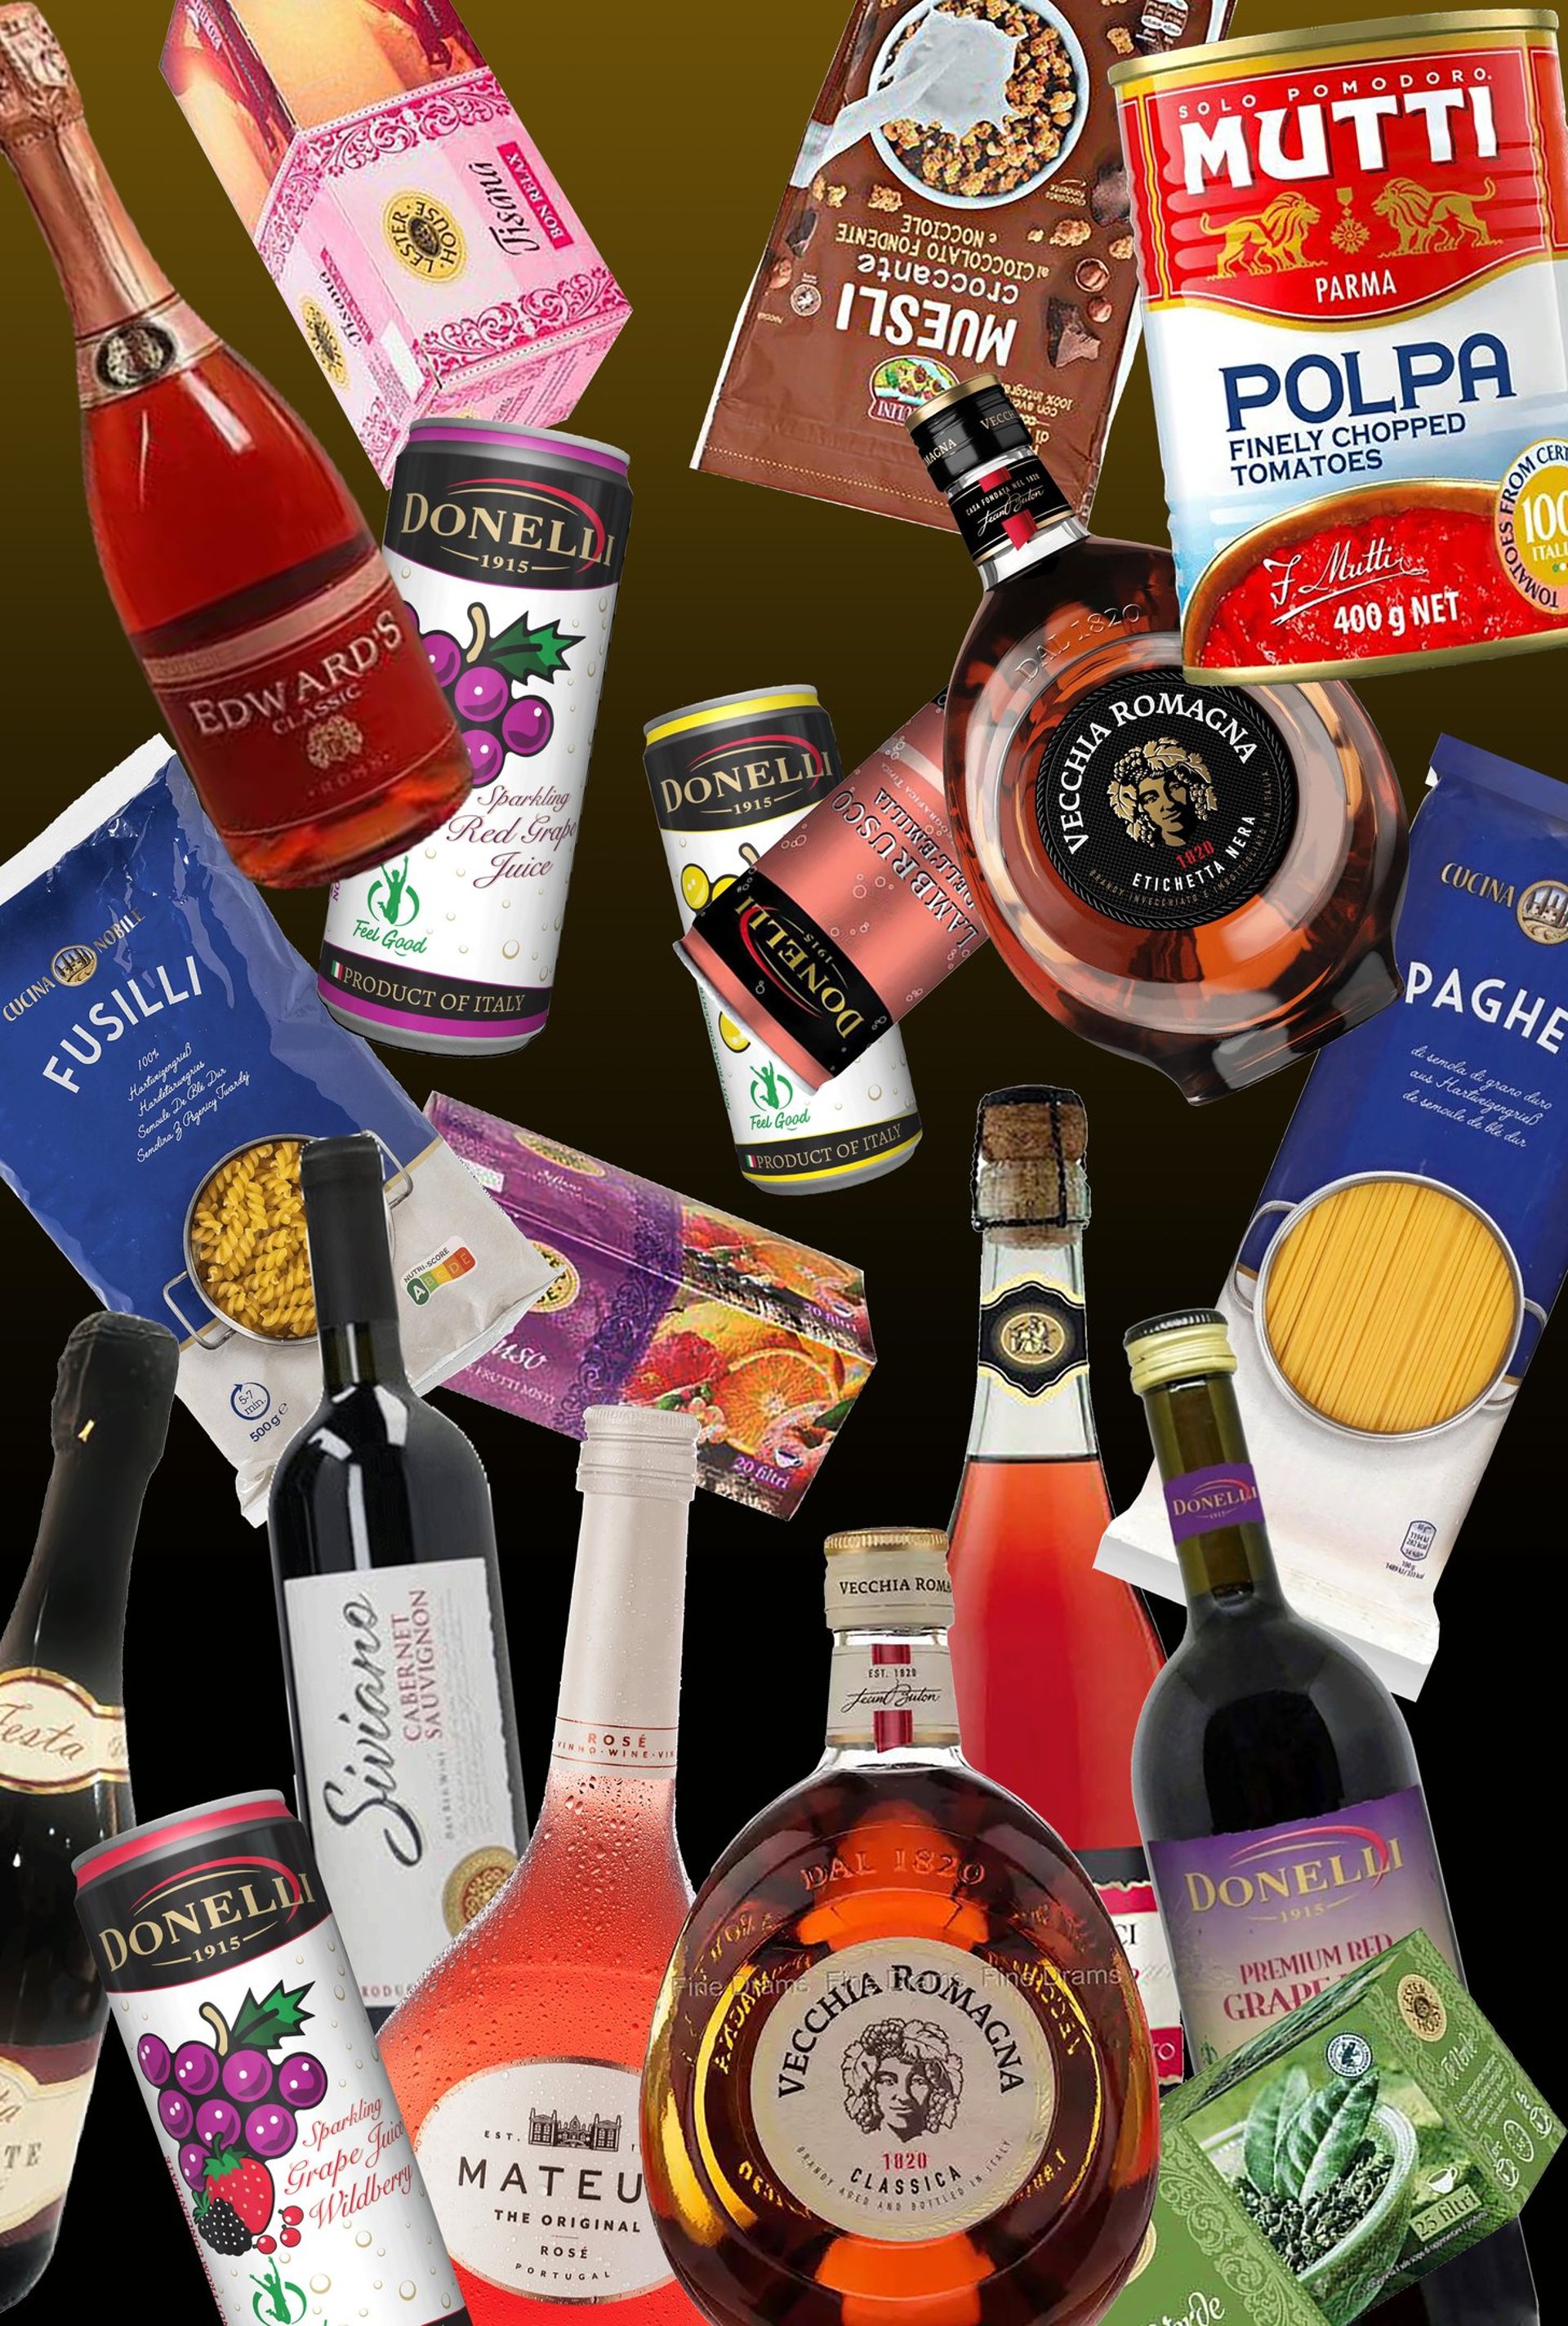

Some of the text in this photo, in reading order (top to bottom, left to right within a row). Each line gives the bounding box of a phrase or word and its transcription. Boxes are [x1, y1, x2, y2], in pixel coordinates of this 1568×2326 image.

[1178, 95, 1257, 120] SOLO
[1179, 86, 1498, 195] MUTTI
[469, 163, 541, 256] Tisana
[507, 153, 565, 239] BON RELAX
[391, 201, 458, 274] LESTER HOUSE
[835, 223, 925, 256] FONDENTE
[900, 214, 987, 249] NOCCIOLE
[858, 252, 1020, 305] croccante
[927, 243, 1036, 283] CIOCCOLATO
[1315, 269, 1397, 304] PARMA
[835, 282, 1018, 368] MUESLI
[1045, 395, 1073, 412] 100%
[1218, 332, 1517, 433] POLPA
[1036, 399, 1059, 417] con
[1230, 412, 1466, 461] FINELY CHOPPED
[1231, 449, 1383, 487] TOMATOES
[965, 503, 981, 517] CASA
[980, 485, 1011, 508] FONDATA
[1011, 478, 1027, 493] NEL
[401, 492, 616, 568] DONELLI
[1499, 456, 1559, 610] TOMATOES FROM
[480, 553, 529, 574] 1915
[1334, 590, 1460, 637] 400 g NET
[1015, 603, 1143, 684] DAL 1820
[189, 609, 403, 736] EDWARD'S
[271, 683, 363, 735] CLASSIC
[660, 750, 834, 815] DONELLI
[1058, 692, 1258, 855] VECCHIA ROMAGNA
[478, 785, 572, 814] Sparkling
[733, 796, 774, 815] 1915
[447, 814, 522, 844] Red
[473, 851, 554, 889] Juice
[831, 789, 980, 949] LAMBRUSCO
[1132, 815, 1256, 892] ETICHETTA NERA
[1089, 868, 1125, 897] BRANDY
[1441, 861, 1517, 909] CUCINA
[353, 919, 428, 956] Feel Good
[804, 933, 834, 965] 1915
[2, 907, 147, 1022] CUCINA NOBILE
[735, 896, 865, 1040] DONELLI
[343, 966, 526, 1014] PRODUCT OF ITALY
[42, 956, 203, 1094] FUSILLI
[137, 1048, 160, 1072] 100%
[1410, 1067, 1434, 1084] aus
[1411, 1045, 1553, 1111] di semola di grano duro
[137, 1067, 227, 1138] Semoule De Blé Dur
[750, 1107, 811, 1131] Feel Good
[1403, 1090, 1527, 1149] de semoule de blé dur
[137, 1131, 175, 1163] Semolina
[755, 1122, 903, 1170] PRODUCT OF ITALY
[403, 1246, 451, 1284] NUTRI-SCORE
[412, 1285, 426, 1301] A
[448, 1262, 460, 1274] D
[459, 1252, 471, 1265] E
[238, 1389, 253, 1405] 5-7
[244, 1398, 267, 1415] min.
[732, 1456, 791, 1490] 20 filtri
[1172, 1486, 1258, 1517] DONELLI
[840, 1578, 911, 1595] VECCHIA
[390, 1612, 423, 1744] CABERNET
[408, 1588, 443, 1741] SAUVIGNON
[868, 1669, 889, 1679] EST.
[557, 1740, 649, 1759] VINHO WINE
[588, 1732, 647, 1749] ROSÉ
[800, 1847, 987, 1892] DAL 1820
[1183, 1836, 1405, 1914] DONELLI
[99, 1873, 316, 1972] DONELLI
[1279, 1903, 1326, 1923] 1915
[191, 1935, 242, 1964] 1915
[1239, 1932, 1393, 1985] PREMIUM RED
[777, 1971, 884, 2099] VECCHIA
[891, 1963, 1026, 2095] ROMAGNA
[302, 2097, 384, 2153] Sparkling
[484, 2130, 521, 2142] EST.
[283, 2144, 363, 2197] Grape
[850, 2164, 962, 2196] CLASSICA
[309, 2163, 413, 2230] Wildberry
[1414, 2189, 1477, 2237] 25 filtri
[494, 2209, 642, 2234] THE ORIGINAL
[514, 2262, 611, 2282] PORTUGAL
[540, 2245, 589, 2260] ROSÉ
